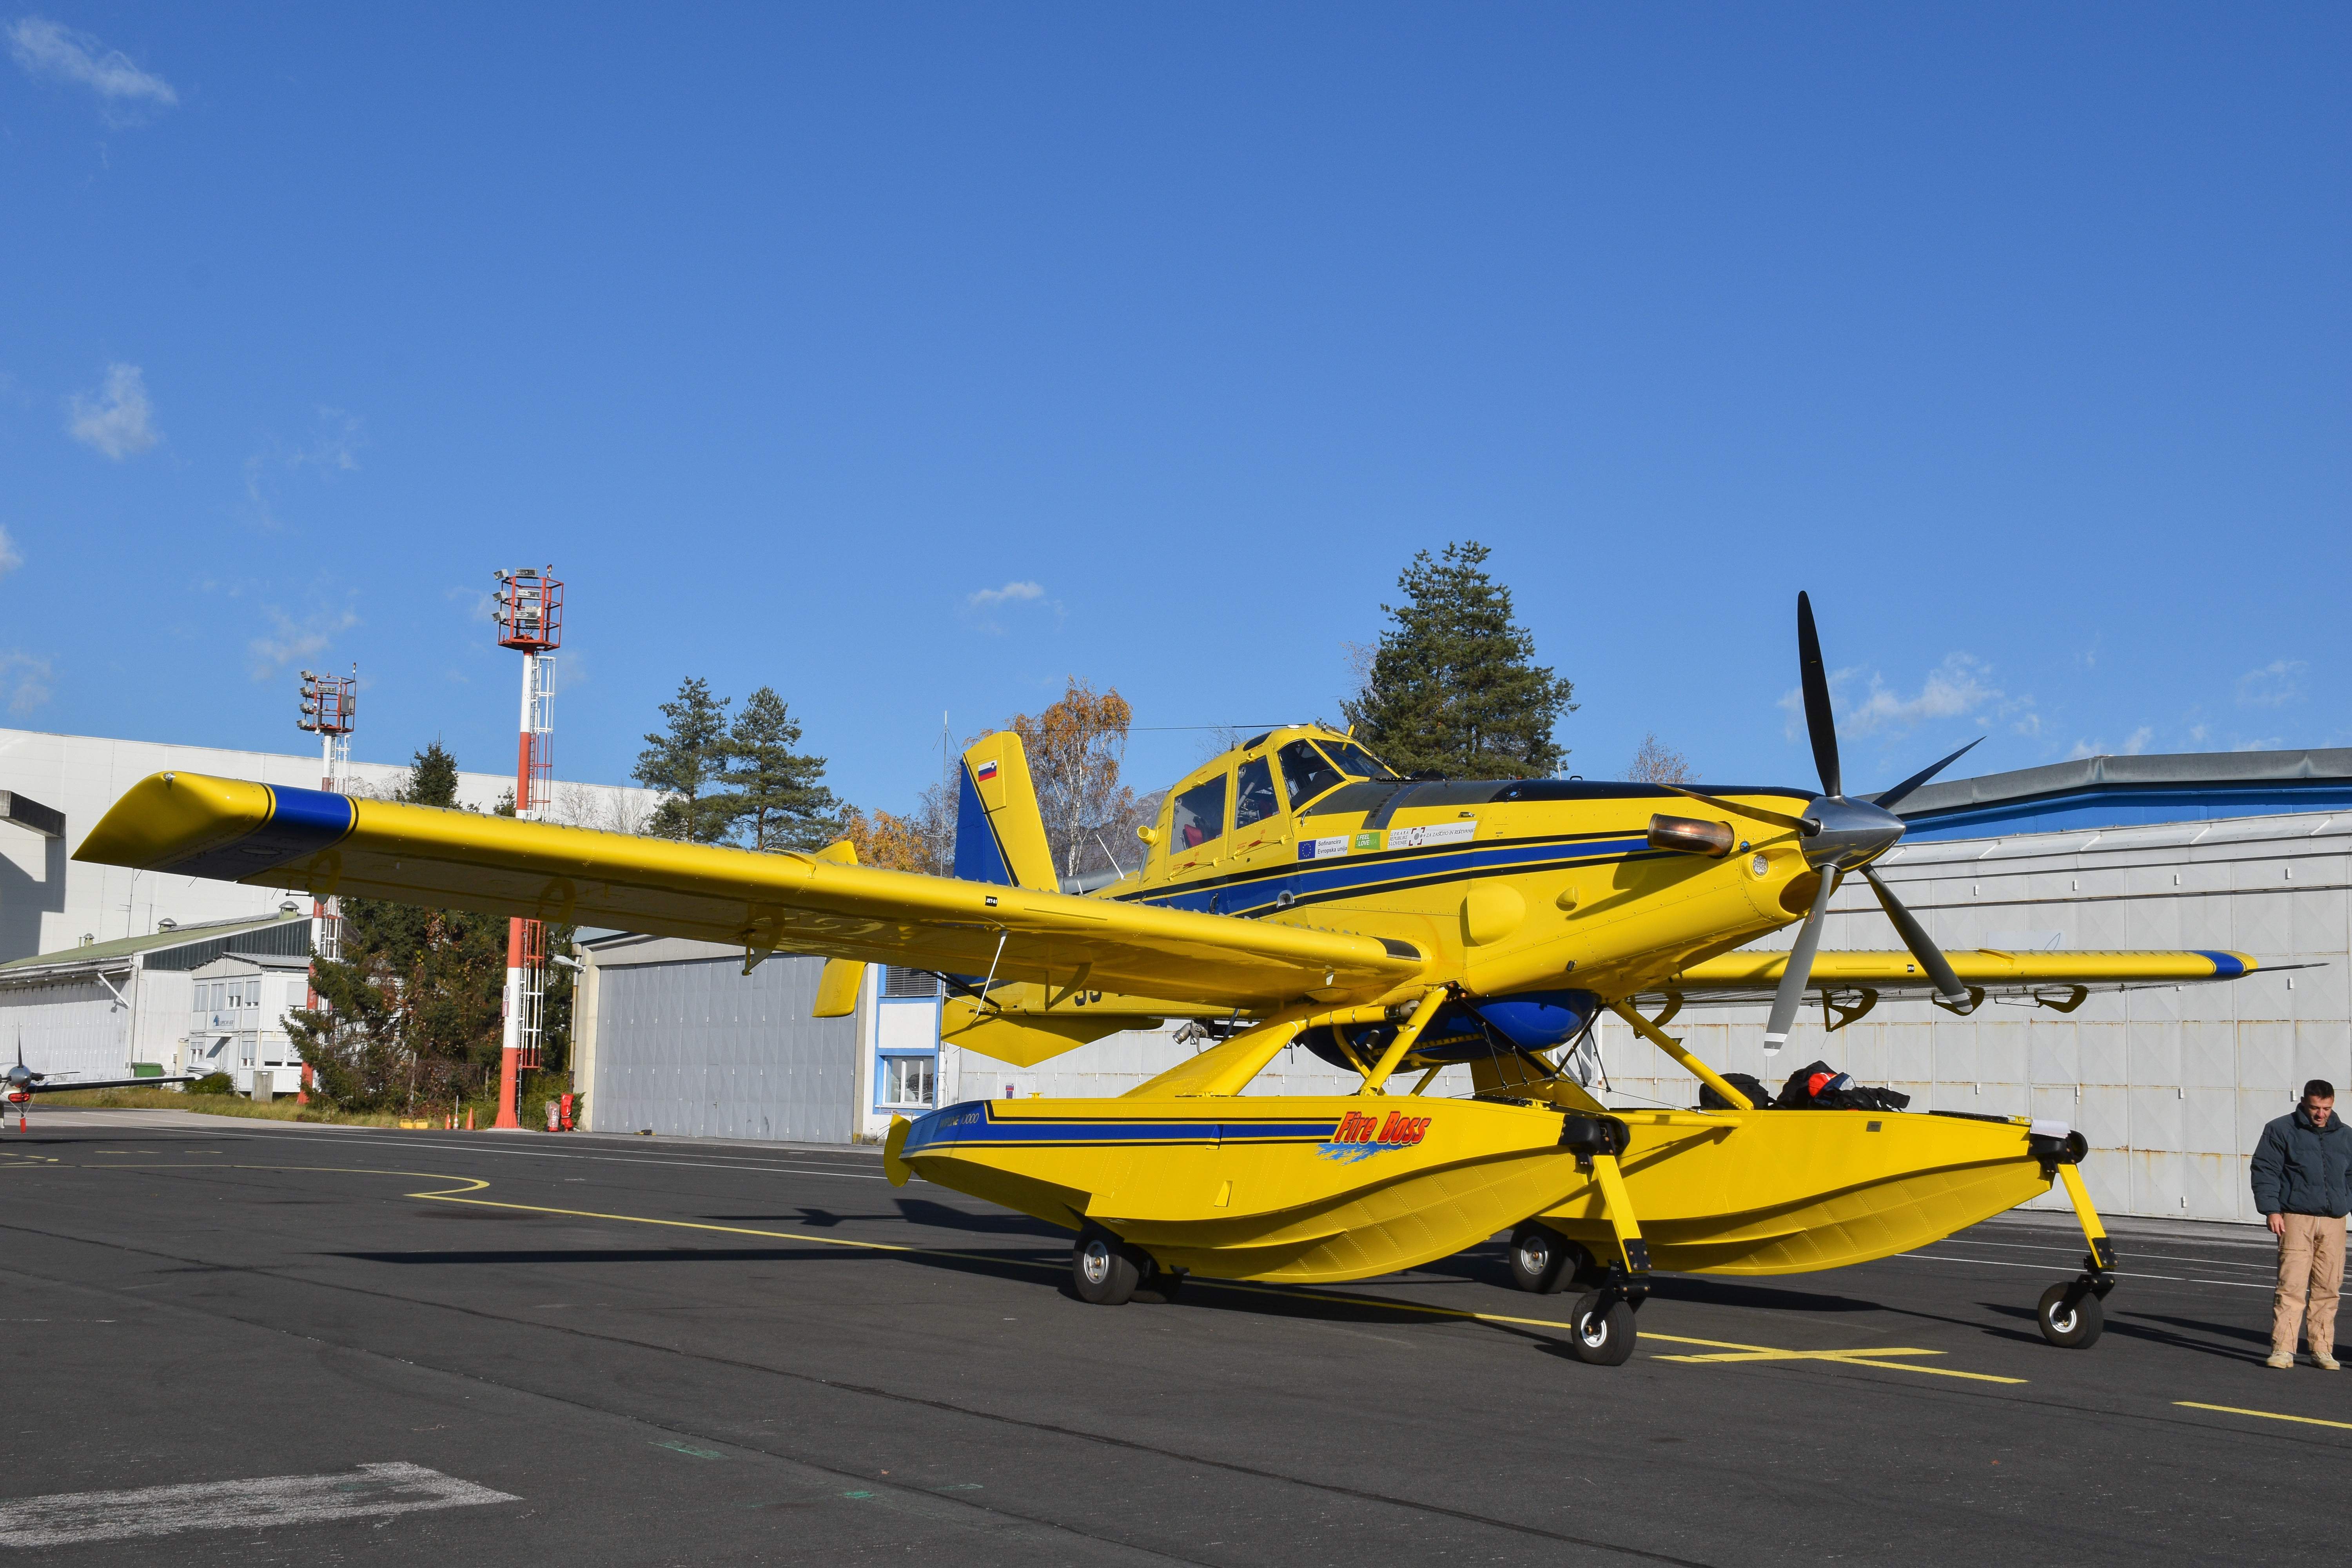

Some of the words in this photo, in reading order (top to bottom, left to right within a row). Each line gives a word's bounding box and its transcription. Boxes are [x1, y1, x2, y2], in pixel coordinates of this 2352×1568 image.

[960, 1113, 979, 1125] 10000
[1334, 1111, 1377, 1144] Fire
[1377, 1111, 1432, 1144] Boss
